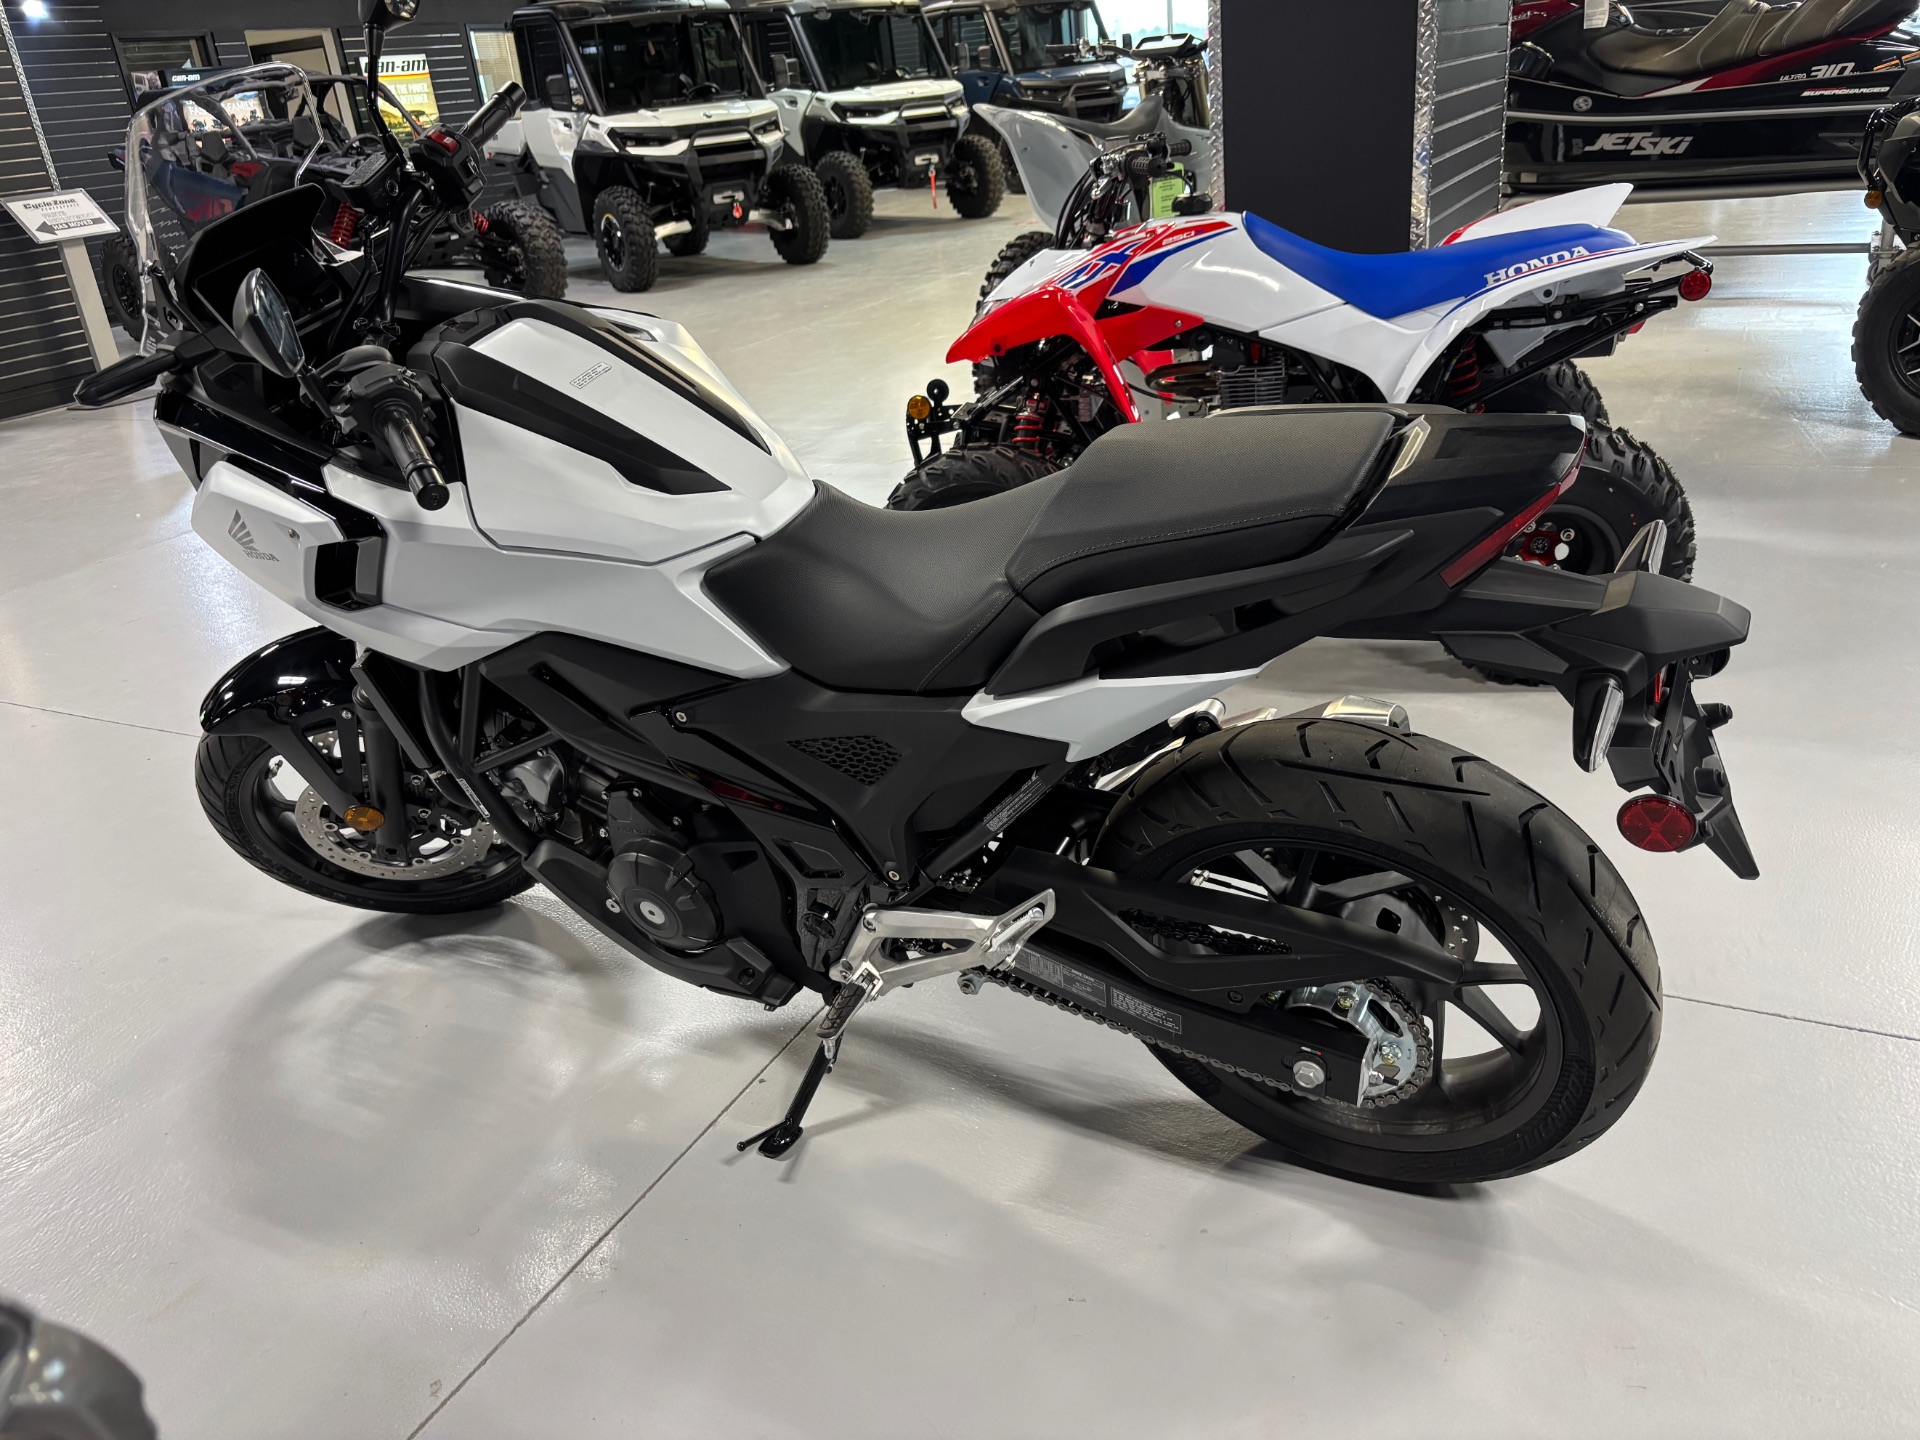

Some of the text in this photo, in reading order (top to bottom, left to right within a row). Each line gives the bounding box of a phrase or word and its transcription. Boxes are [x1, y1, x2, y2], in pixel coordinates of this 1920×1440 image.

[1780, 73, 1807, 81] ULTRA
[1811, 62, 1855, 78] 310
[1800, 86, 1891, 97] SUPERCHARGED
[70, 219, 94, 229] MOVED
[1484, 246, 1591, 287] HONDA
[243, 549, 280, 562] HONDA
